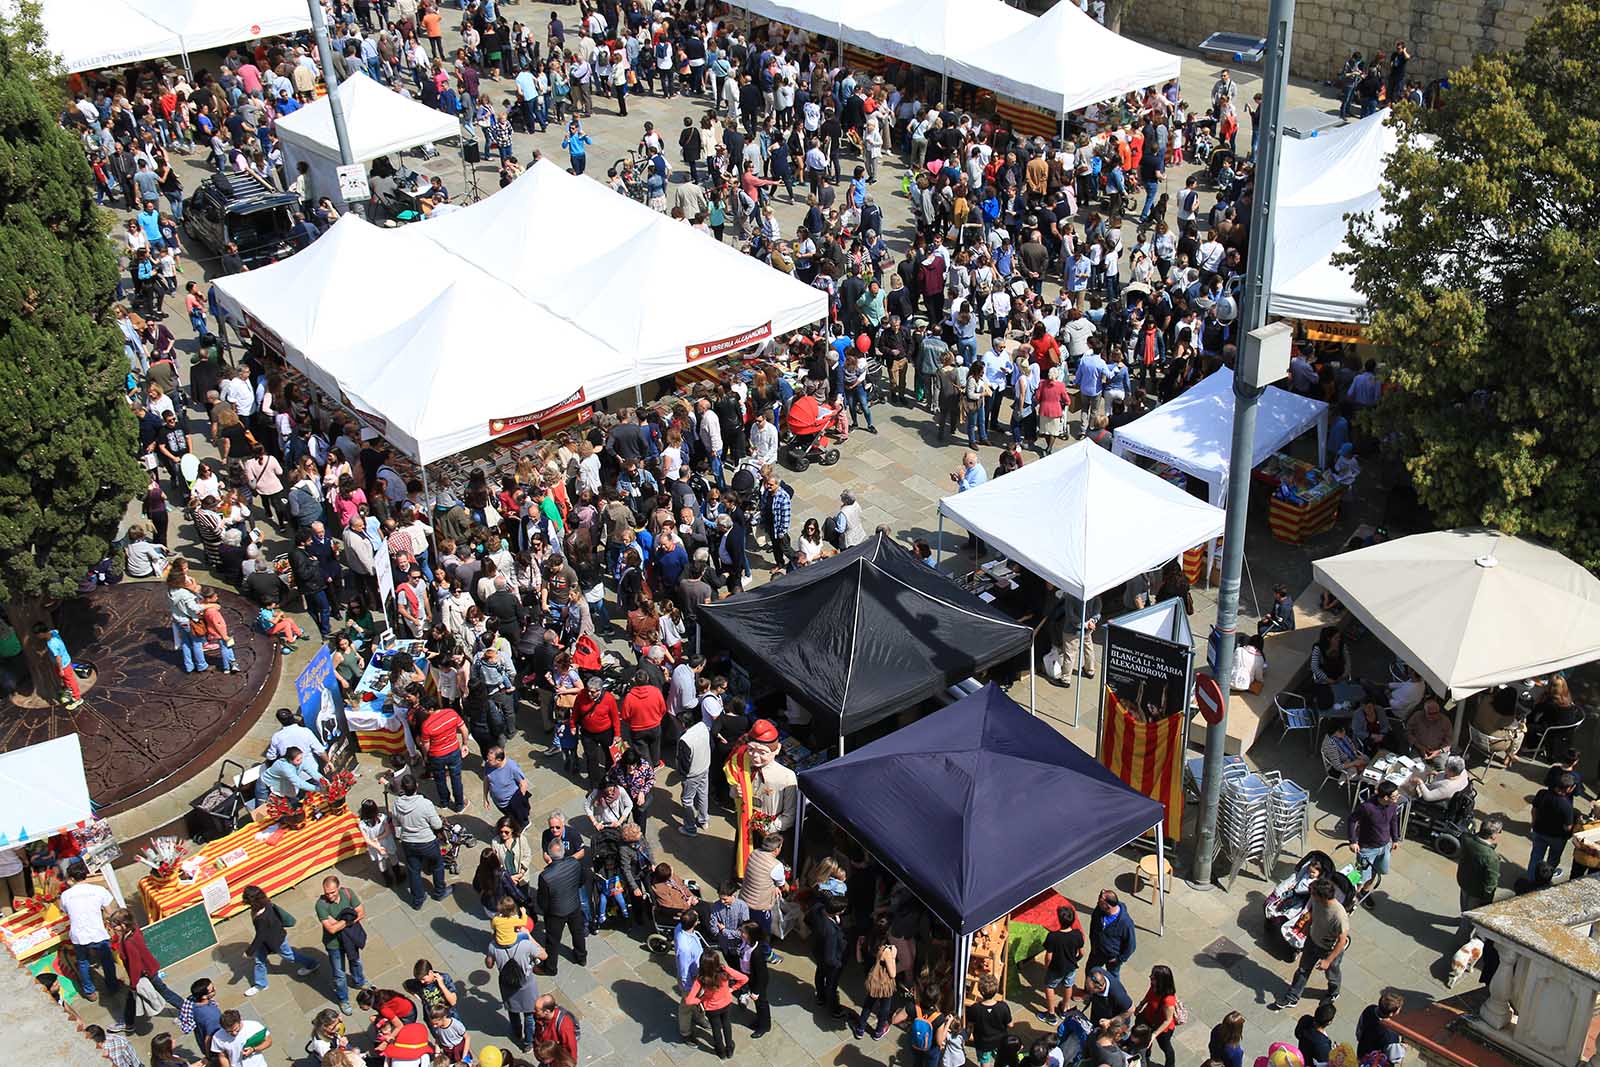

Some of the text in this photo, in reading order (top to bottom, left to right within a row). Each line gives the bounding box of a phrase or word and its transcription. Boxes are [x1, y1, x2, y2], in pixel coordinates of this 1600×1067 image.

[1316, 324, 1360, 336] Abacus
[703, 340, 734, 355] LLIBRERIA
[1110, 650, 1142, 665] BLANCA
[1156, 663, 1184, 677] MARIA
[1110, 658, 1168, 680] ALEXANDROVA
